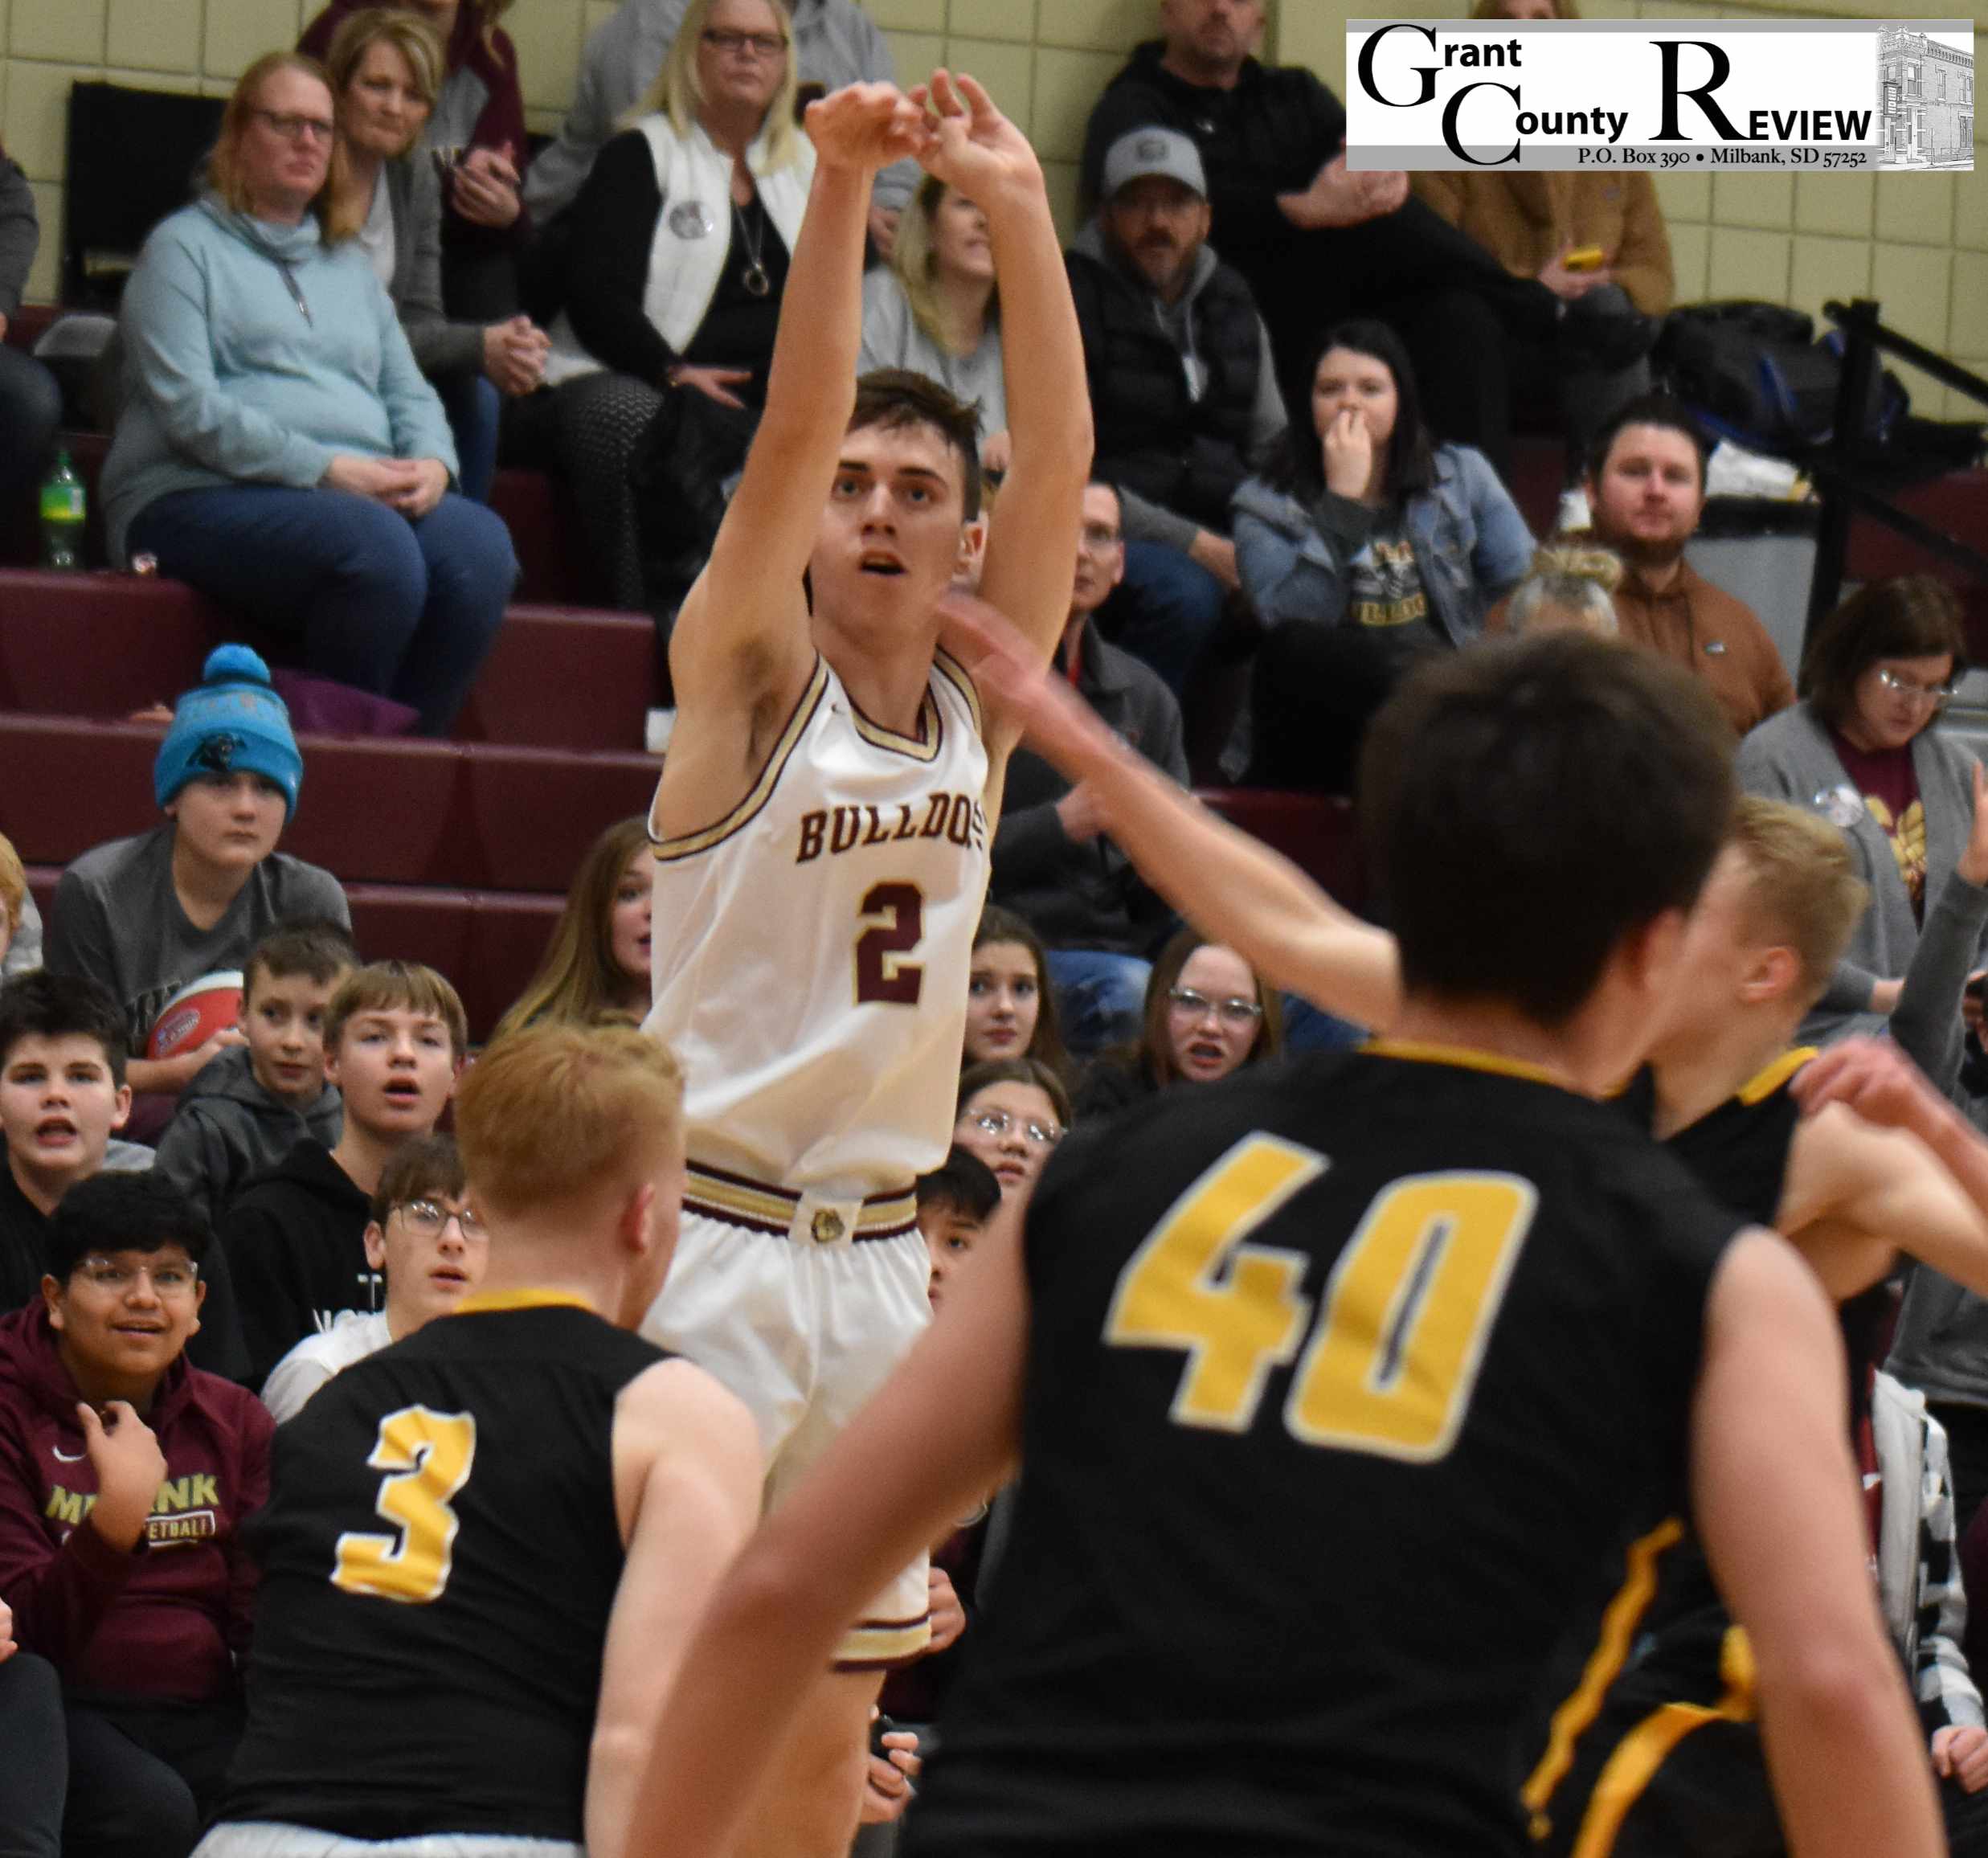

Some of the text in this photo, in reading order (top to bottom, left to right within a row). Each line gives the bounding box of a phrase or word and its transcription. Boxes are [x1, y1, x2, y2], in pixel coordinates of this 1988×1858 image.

[853, 881, 925, 1006] 2
[1101, 1130, 1540, 1464] 40
[329, 1403, 477, 1603] 3
